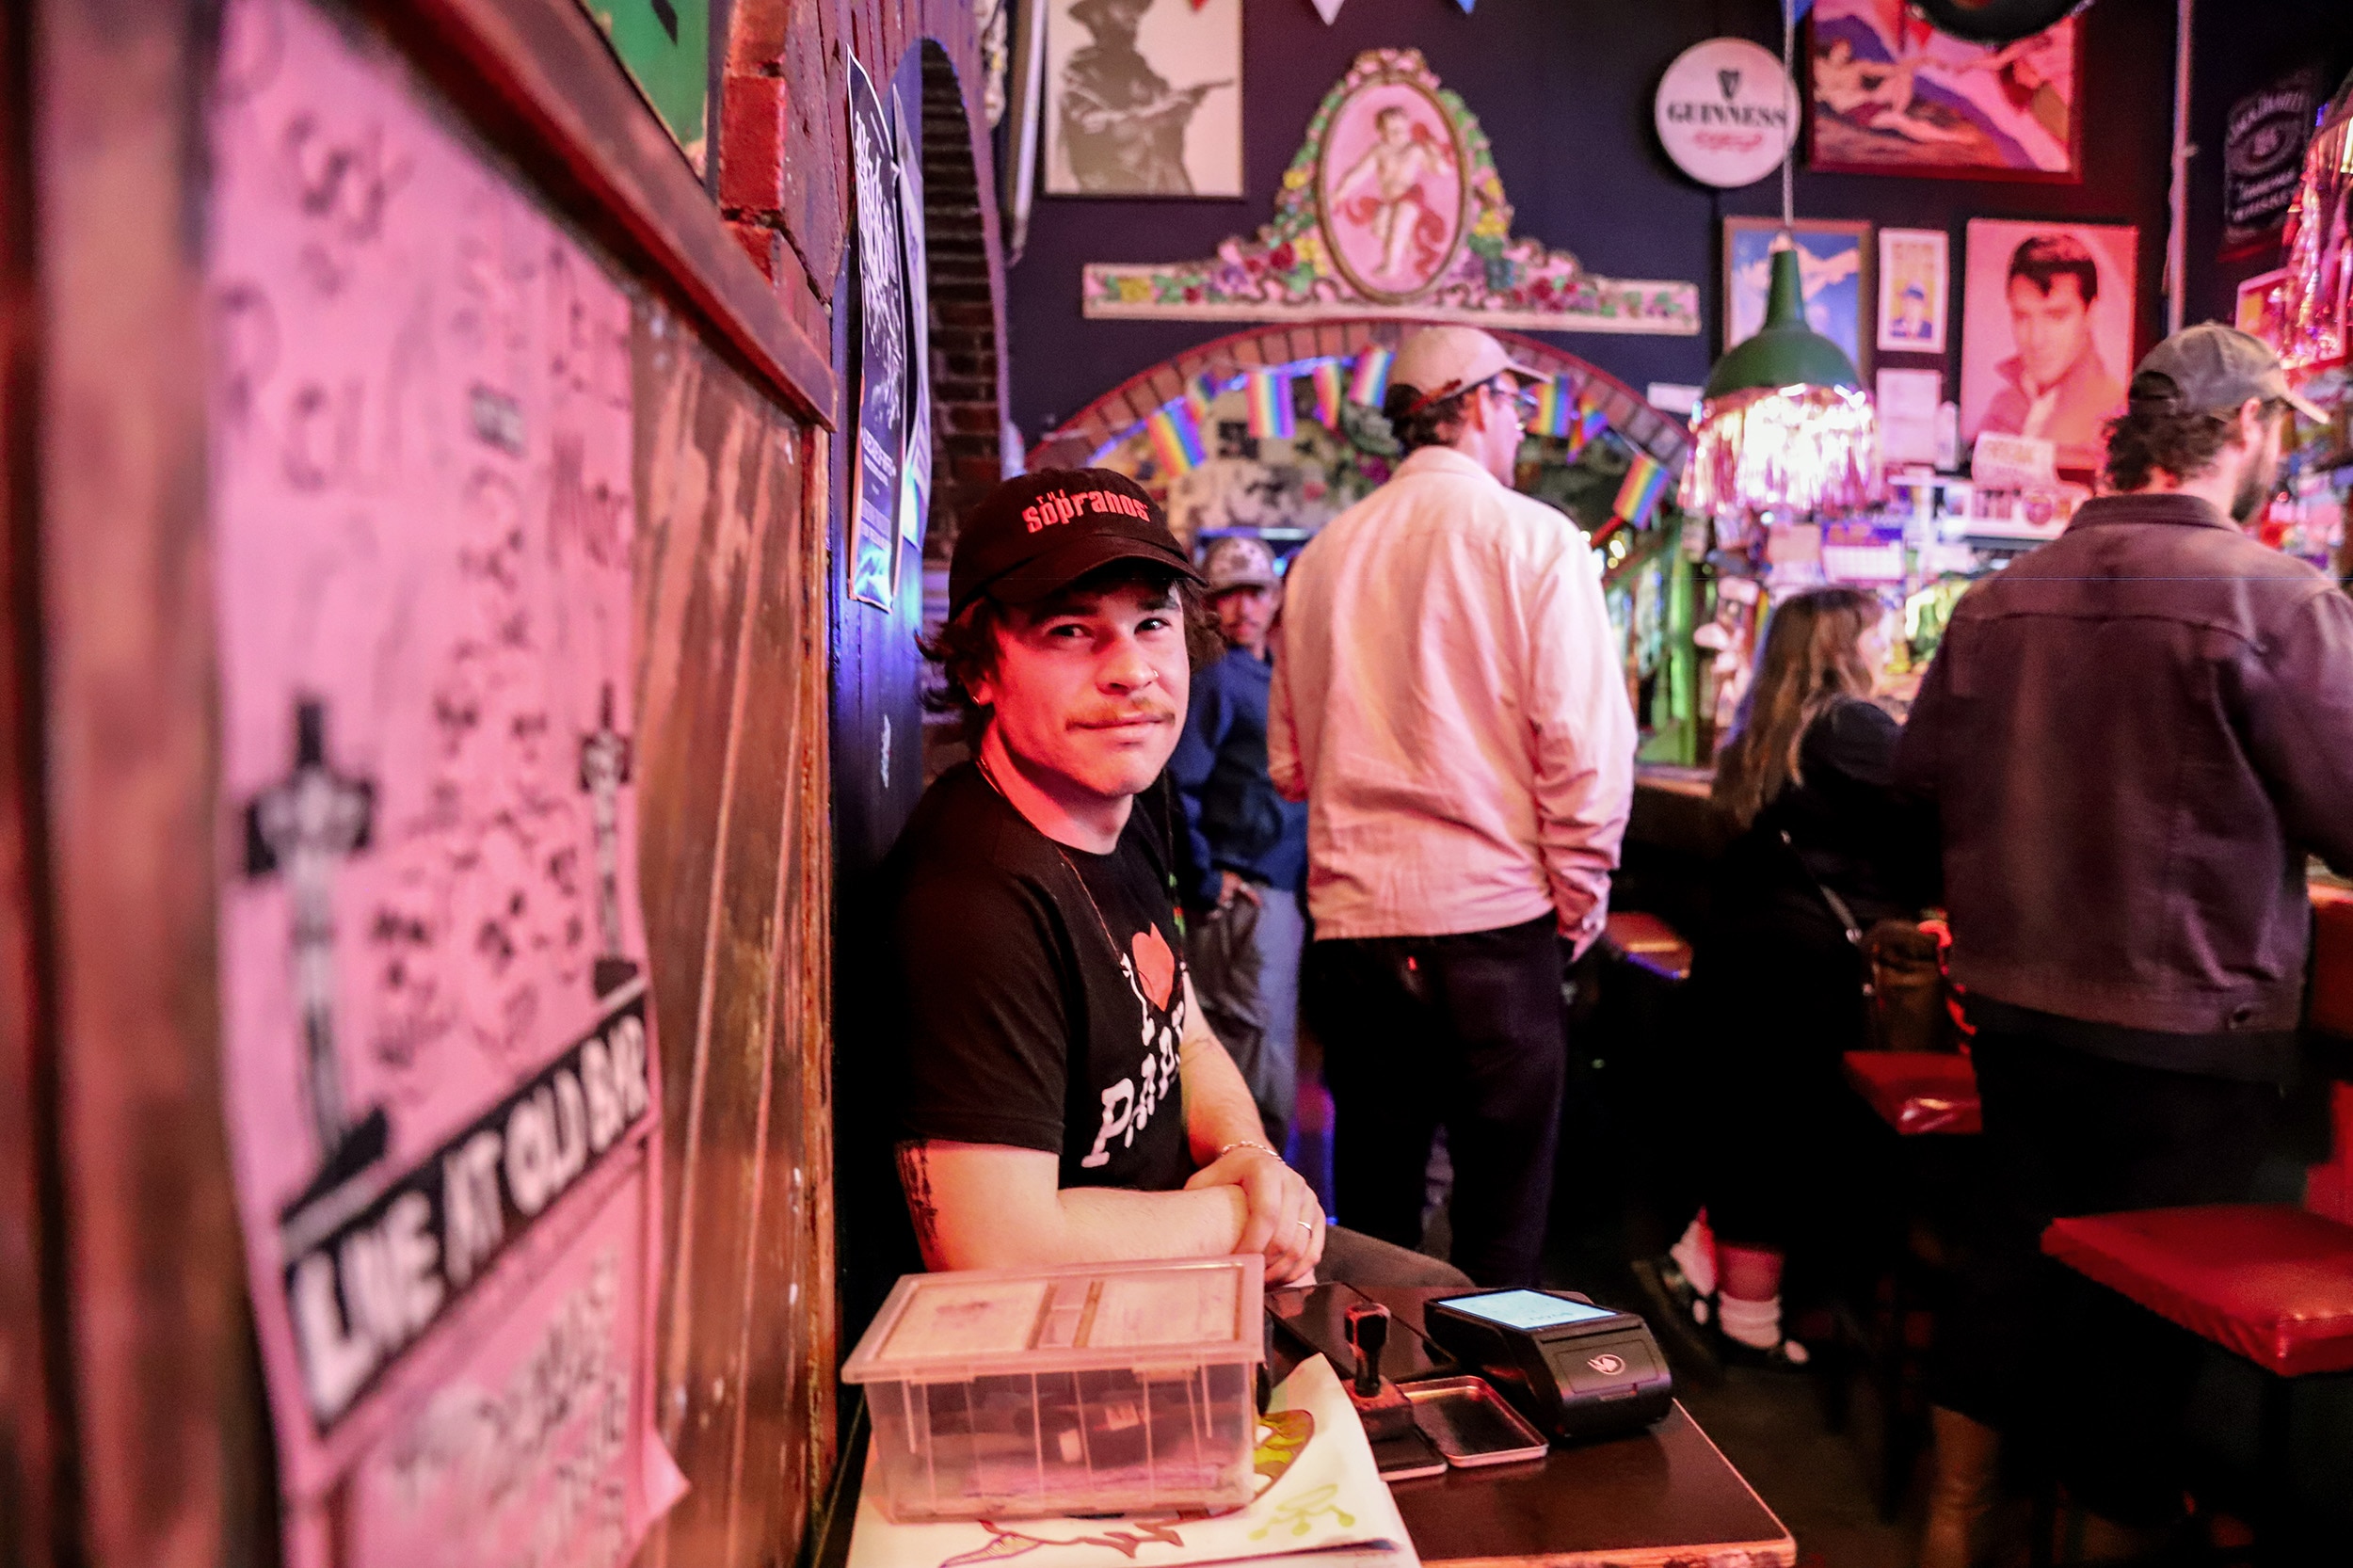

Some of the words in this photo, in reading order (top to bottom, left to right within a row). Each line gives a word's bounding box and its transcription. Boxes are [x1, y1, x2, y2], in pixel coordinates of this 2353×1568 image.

[1667, 104, 1786, 128] GUINNESS
[441, 1129, 505, 1288] AT
[504, 1067, 589, 1217] OLD
